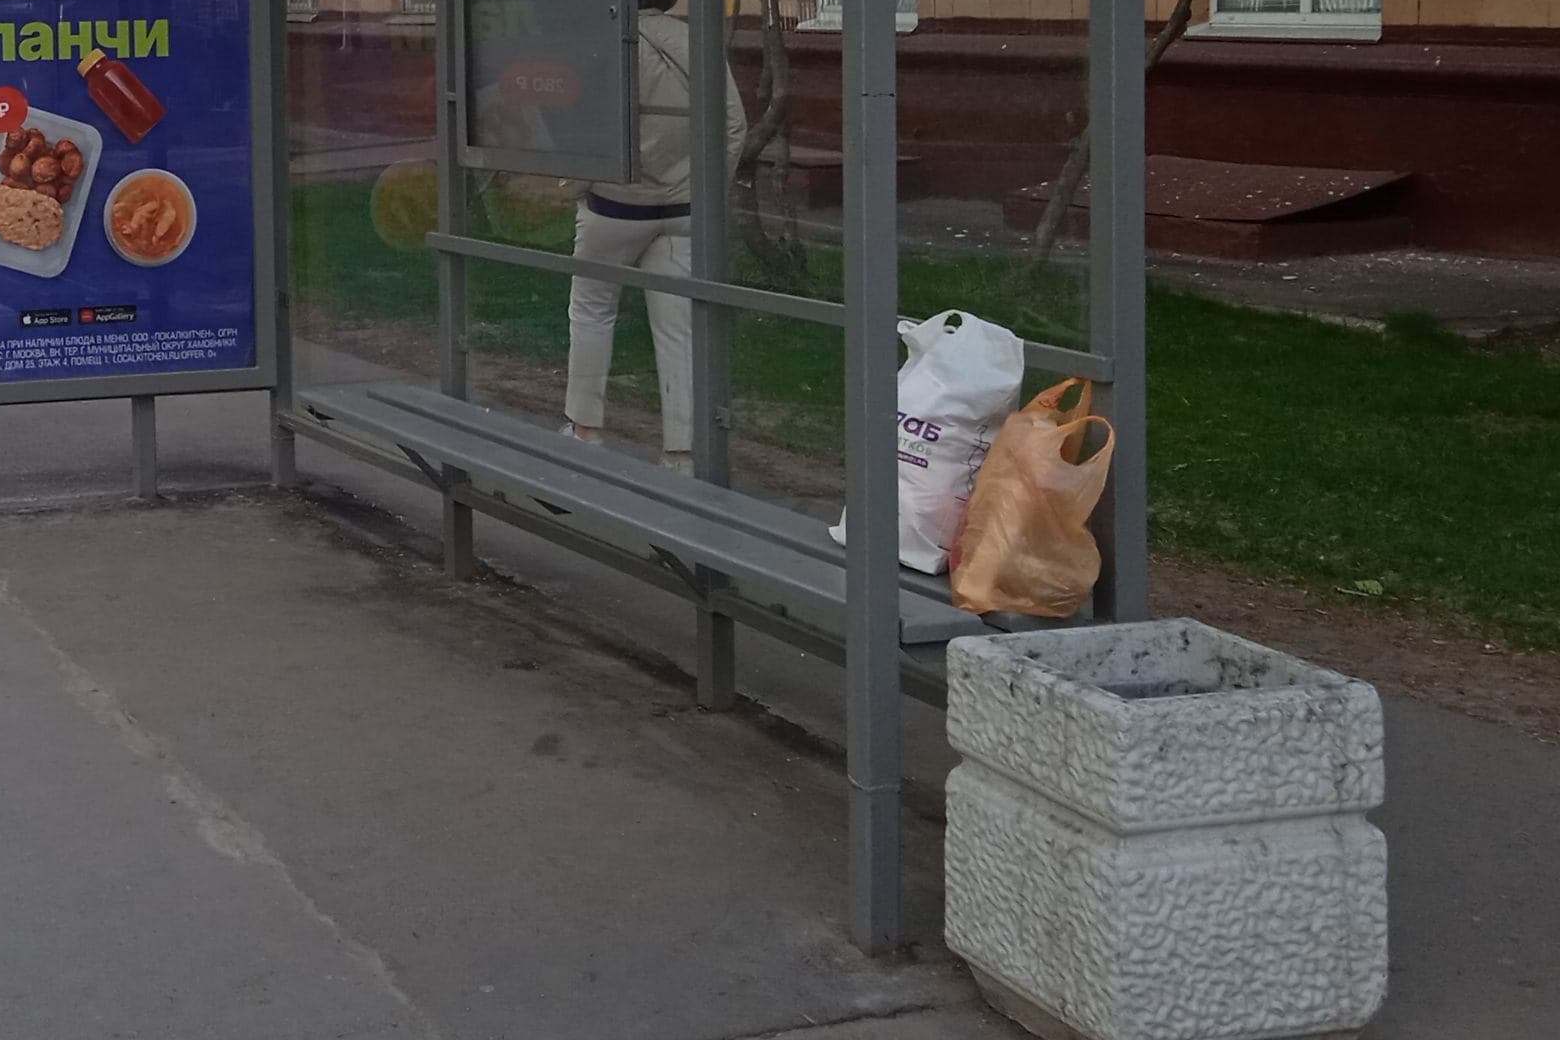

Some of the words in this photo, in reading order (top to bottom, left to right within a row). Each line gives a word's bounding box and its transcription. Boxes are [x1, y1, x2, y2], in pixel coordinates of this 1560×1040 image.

[50, 315, 69, 324] Store
[96, 313, 134, 322] AppGallery
[7, 339, 24, 349] ПРИ
[25, 336, 64, 347] НАЛИЧИИ
[65, 334, 95, 346] БЛЮДА
[131, 332, 149, 342] ООО
[161, 340, 185, 351] ОКРУГ
[4, 359, 24, 370] ДОМ
[38, 357, 61, 368] ЭТАЖ
